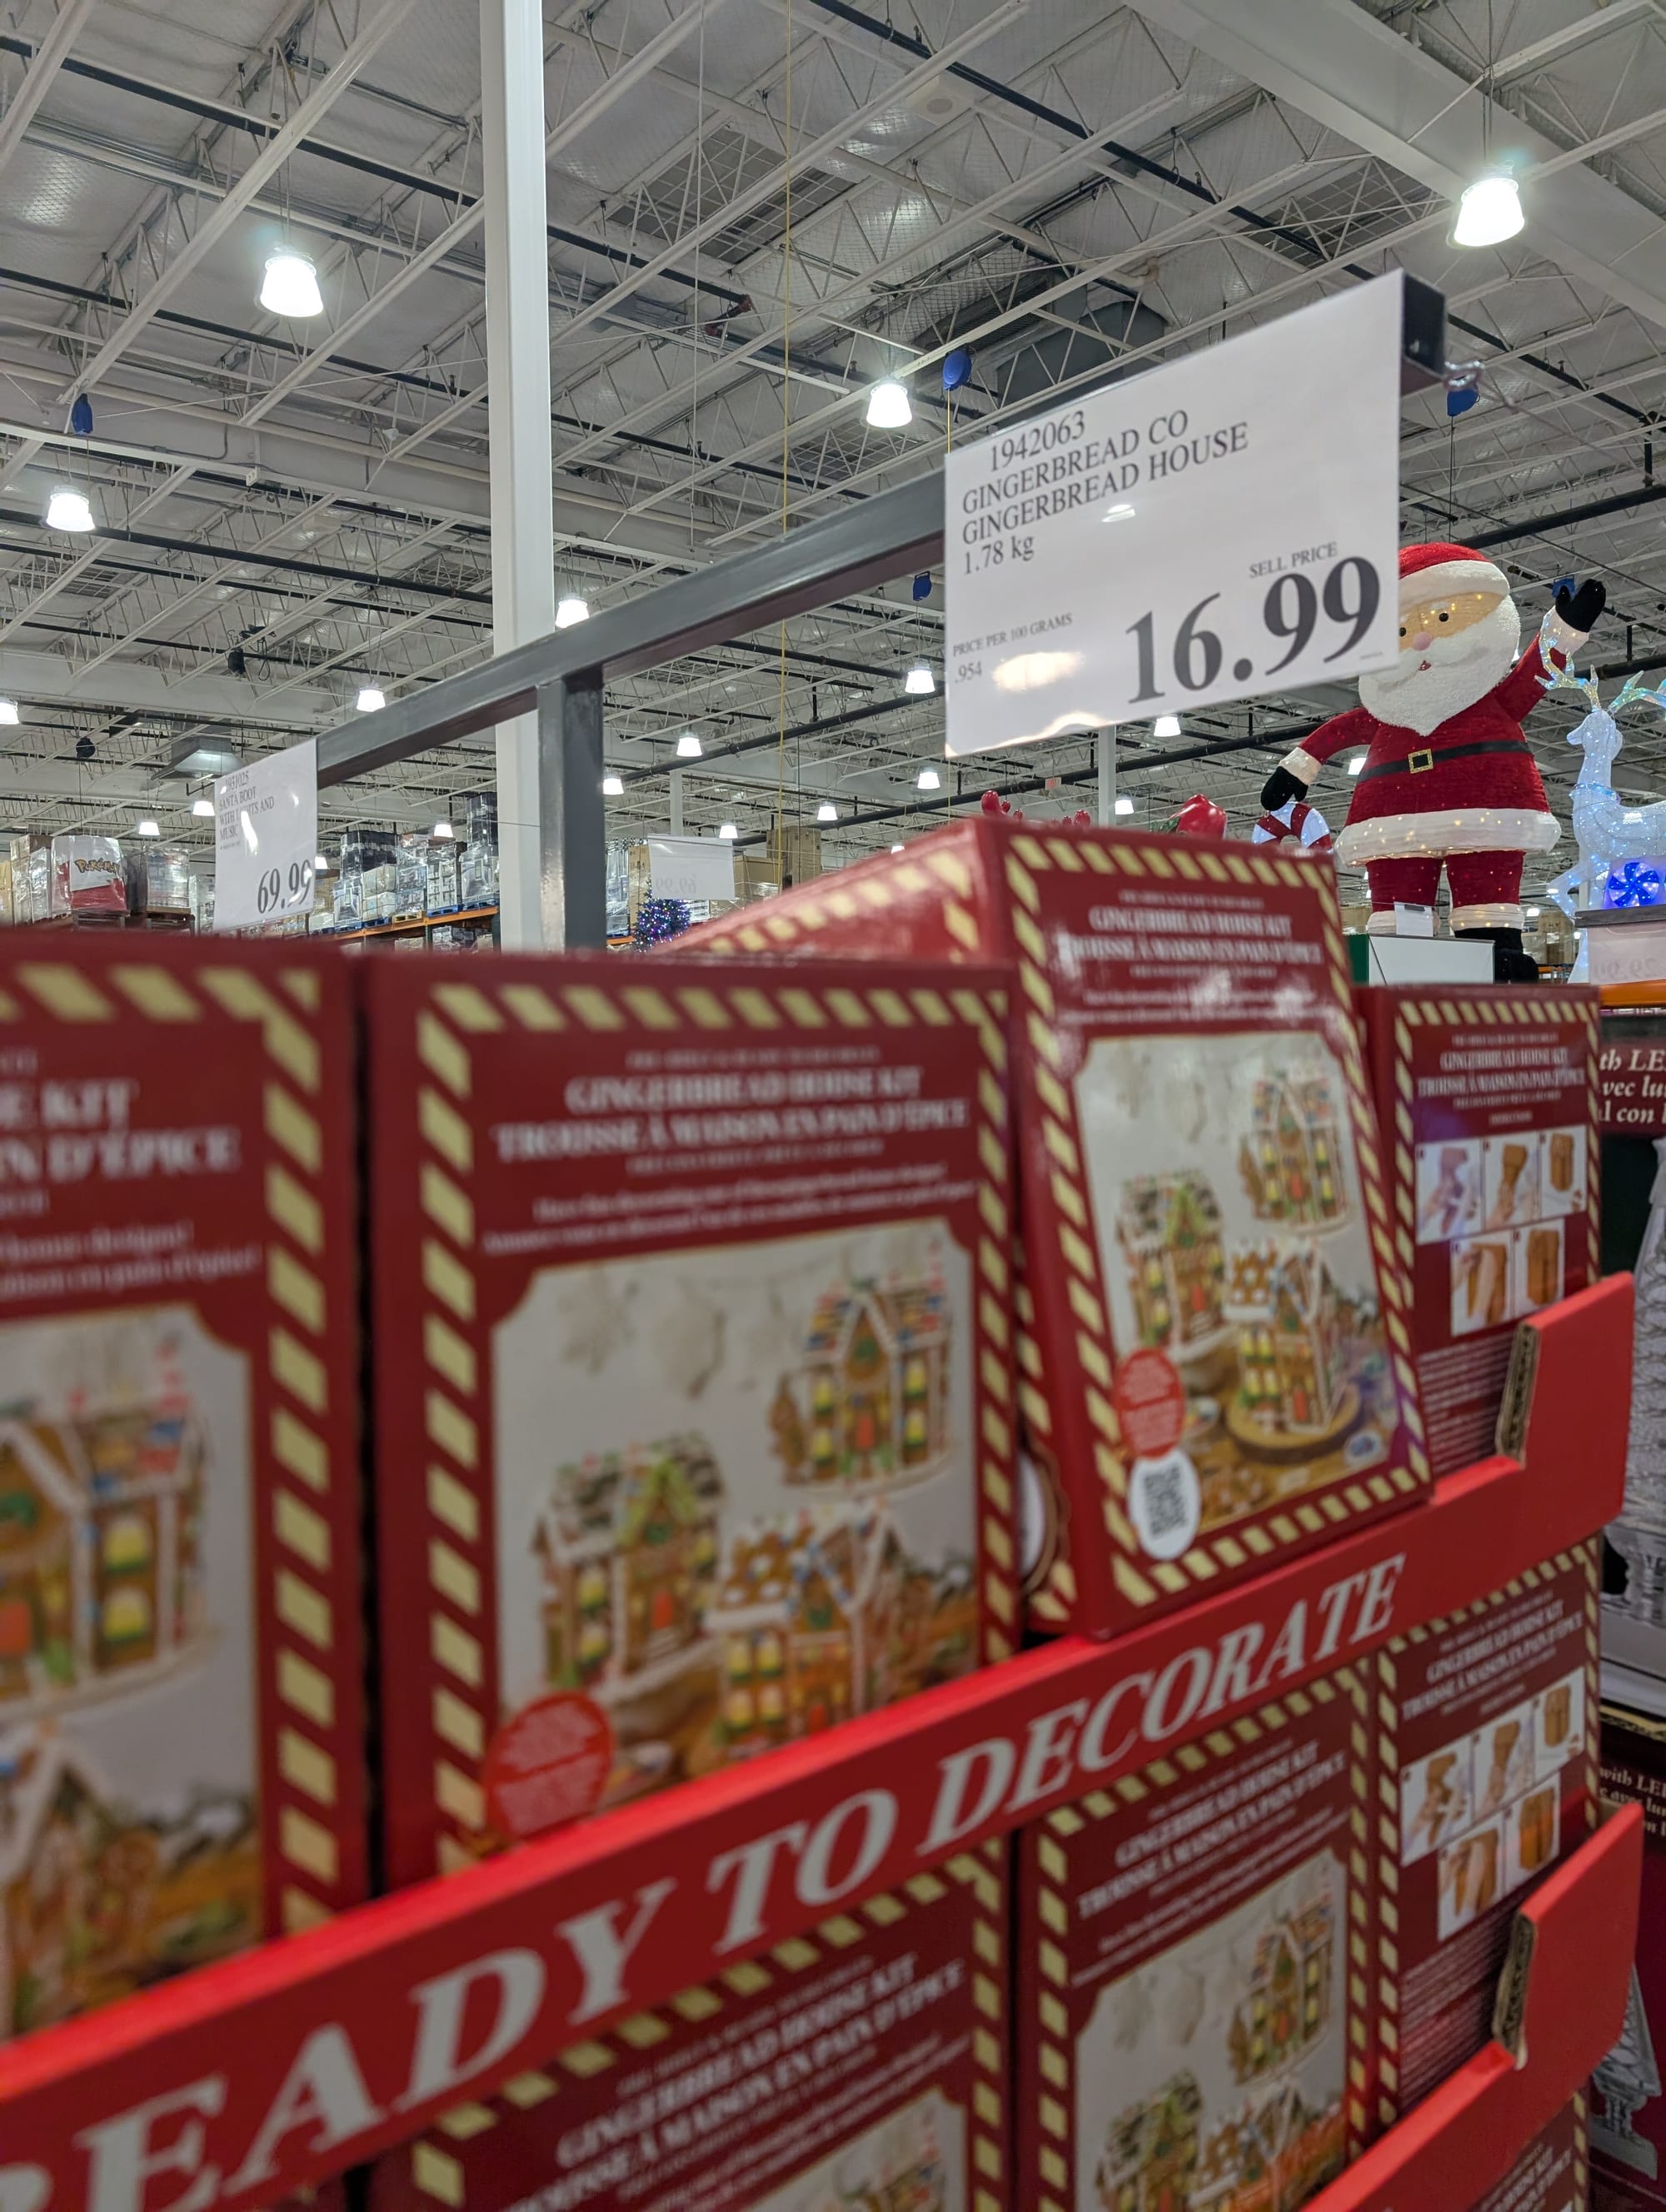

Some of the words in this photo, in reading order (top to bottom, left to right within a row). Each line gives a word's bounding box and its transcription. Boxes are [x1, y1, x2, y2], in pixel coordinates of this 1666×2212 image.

[962, 428, 1140, 515] GINGERBREAD
[1148, 409, 1189, 446] CO
[990, 411, 1085, 472] 1942063
[962, 462, 1140, 546] GINGERBREAD
[1148, 421, 1249, 481] HOUSE
[965, 540, 1005, 575] 1.78
[1010, 535, 1035, 562] kg
[1249, 556, 1288, 580] SELL
[1290, 541, 1339, 568] PRICE
[952, 637, 984, 657] PRICE
[985, 630, 1007, 648] PER
[1010, 625, 1029, 641] 100
[1030, 612, 1074, 636] GRAMS
[1125, 555, 1381, 705] 16.99
[954, 660, 983, 684] .954
[257, 859, 312, 914] 69.99
[1642, 1074, 1666, 1098] lu
[1616, 1107, 1655, 1124] con
[706, 1788, 900, 1955] TO
[915, 1552, 1407, 1859] DECORATE
